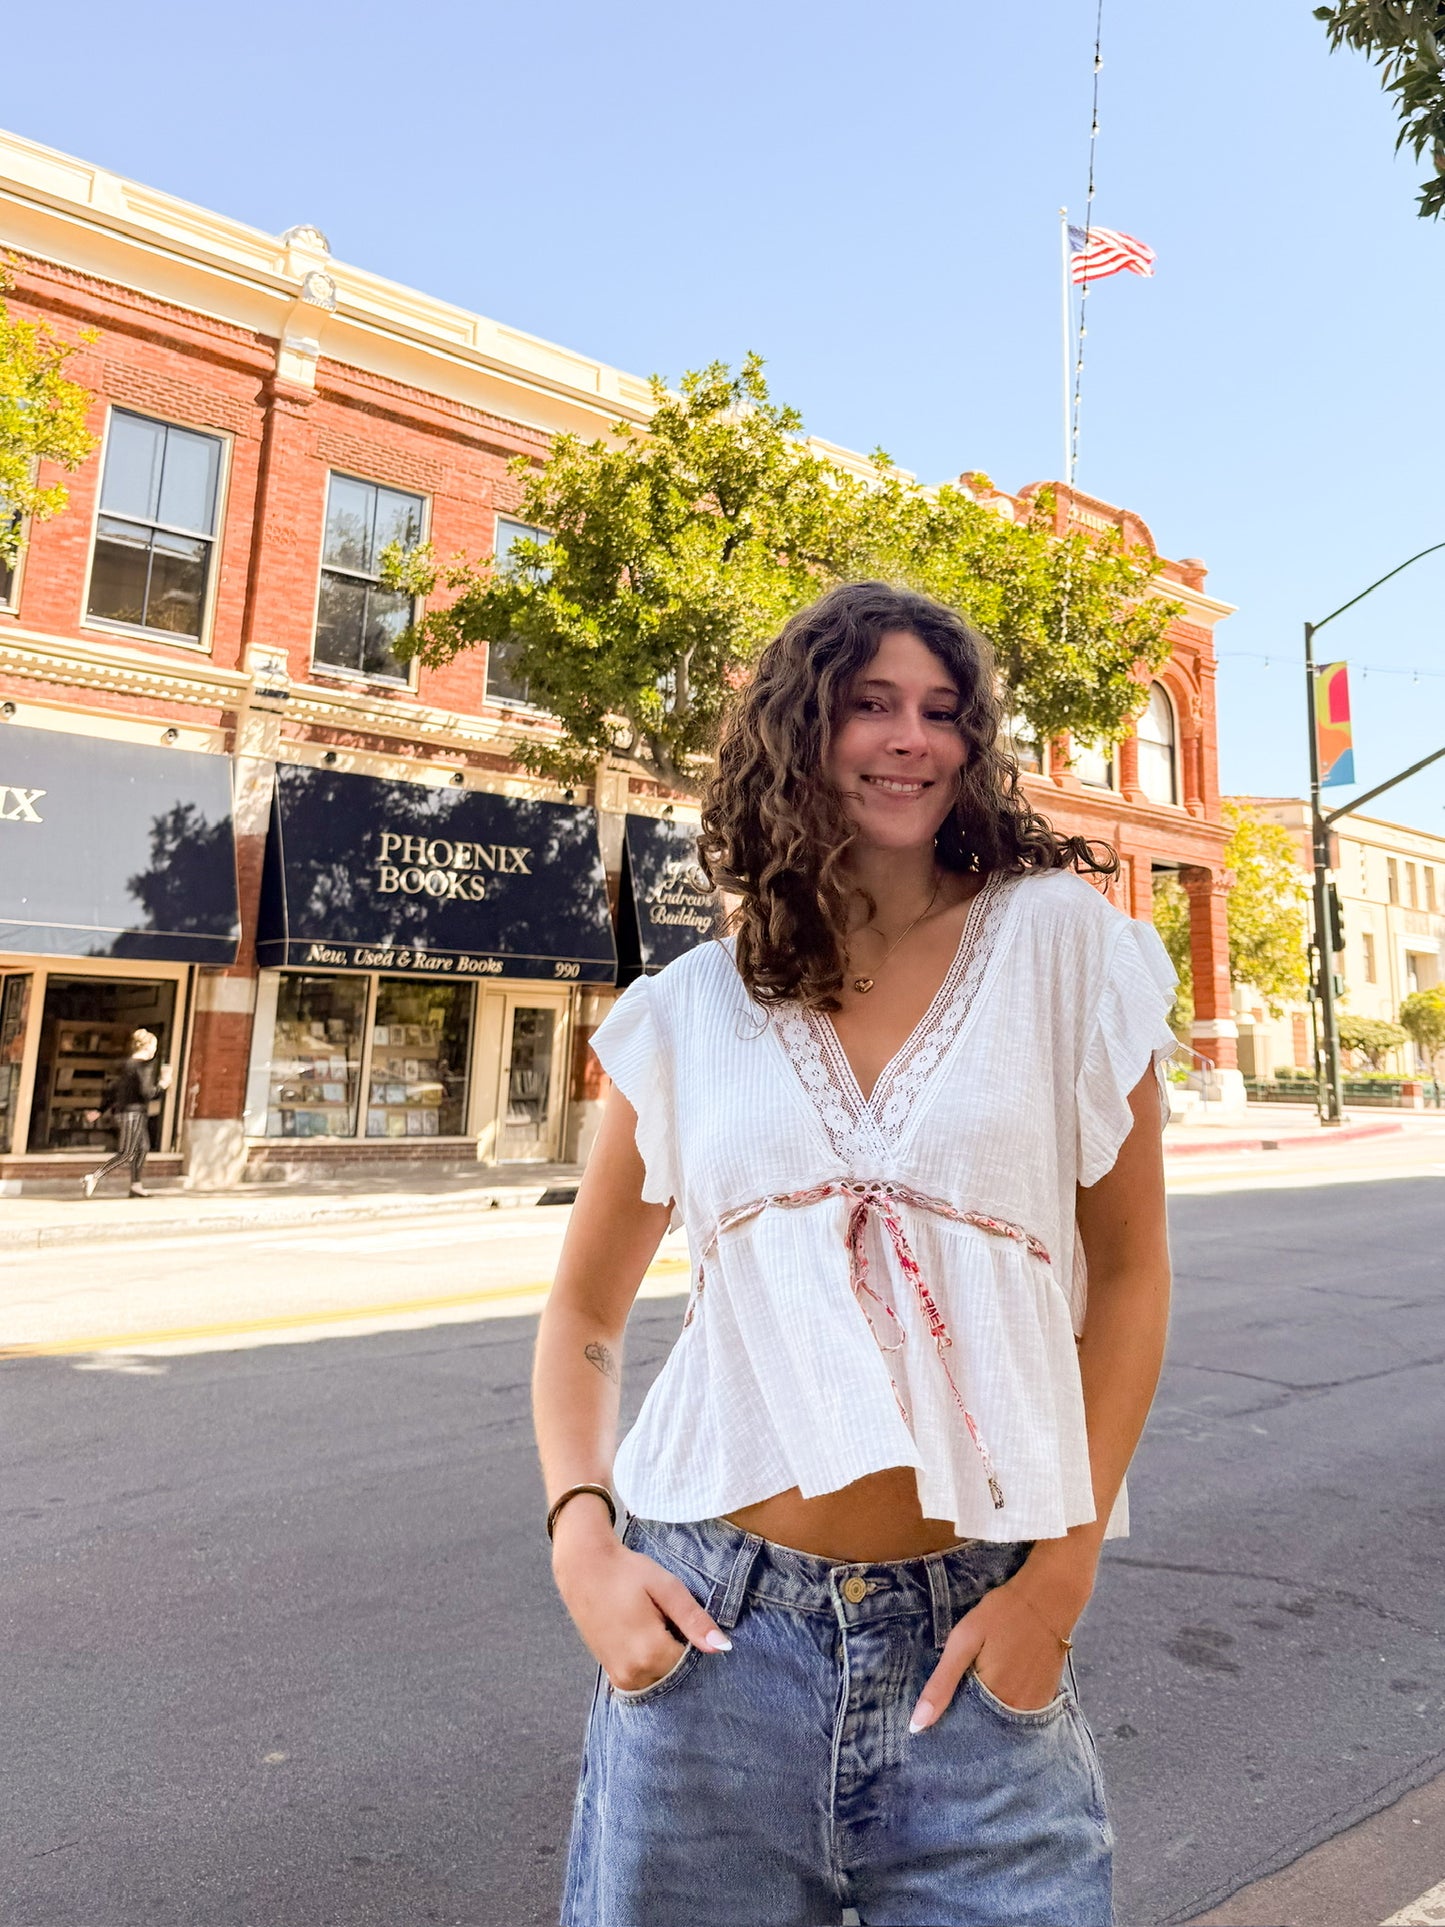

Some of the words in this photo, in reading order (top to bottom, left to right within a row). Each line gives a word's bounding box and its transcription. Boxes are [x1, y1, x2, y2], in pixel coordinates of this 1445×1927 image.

[376, 832, 533, 875] PHOENIX
[377, 866, 486, 901] BOOKS
[645, 886, 714, 907] Andrews
[649, 904, 713, 934] Building
[306, 943, 348, 966] New,
[354, 948, 395, 967] Used
[397, 950, 412, 968] &
[412, 951, 454, 971] Rare
[456, 955, 504, 973] Books
[554, 961, 581, 978] 990
